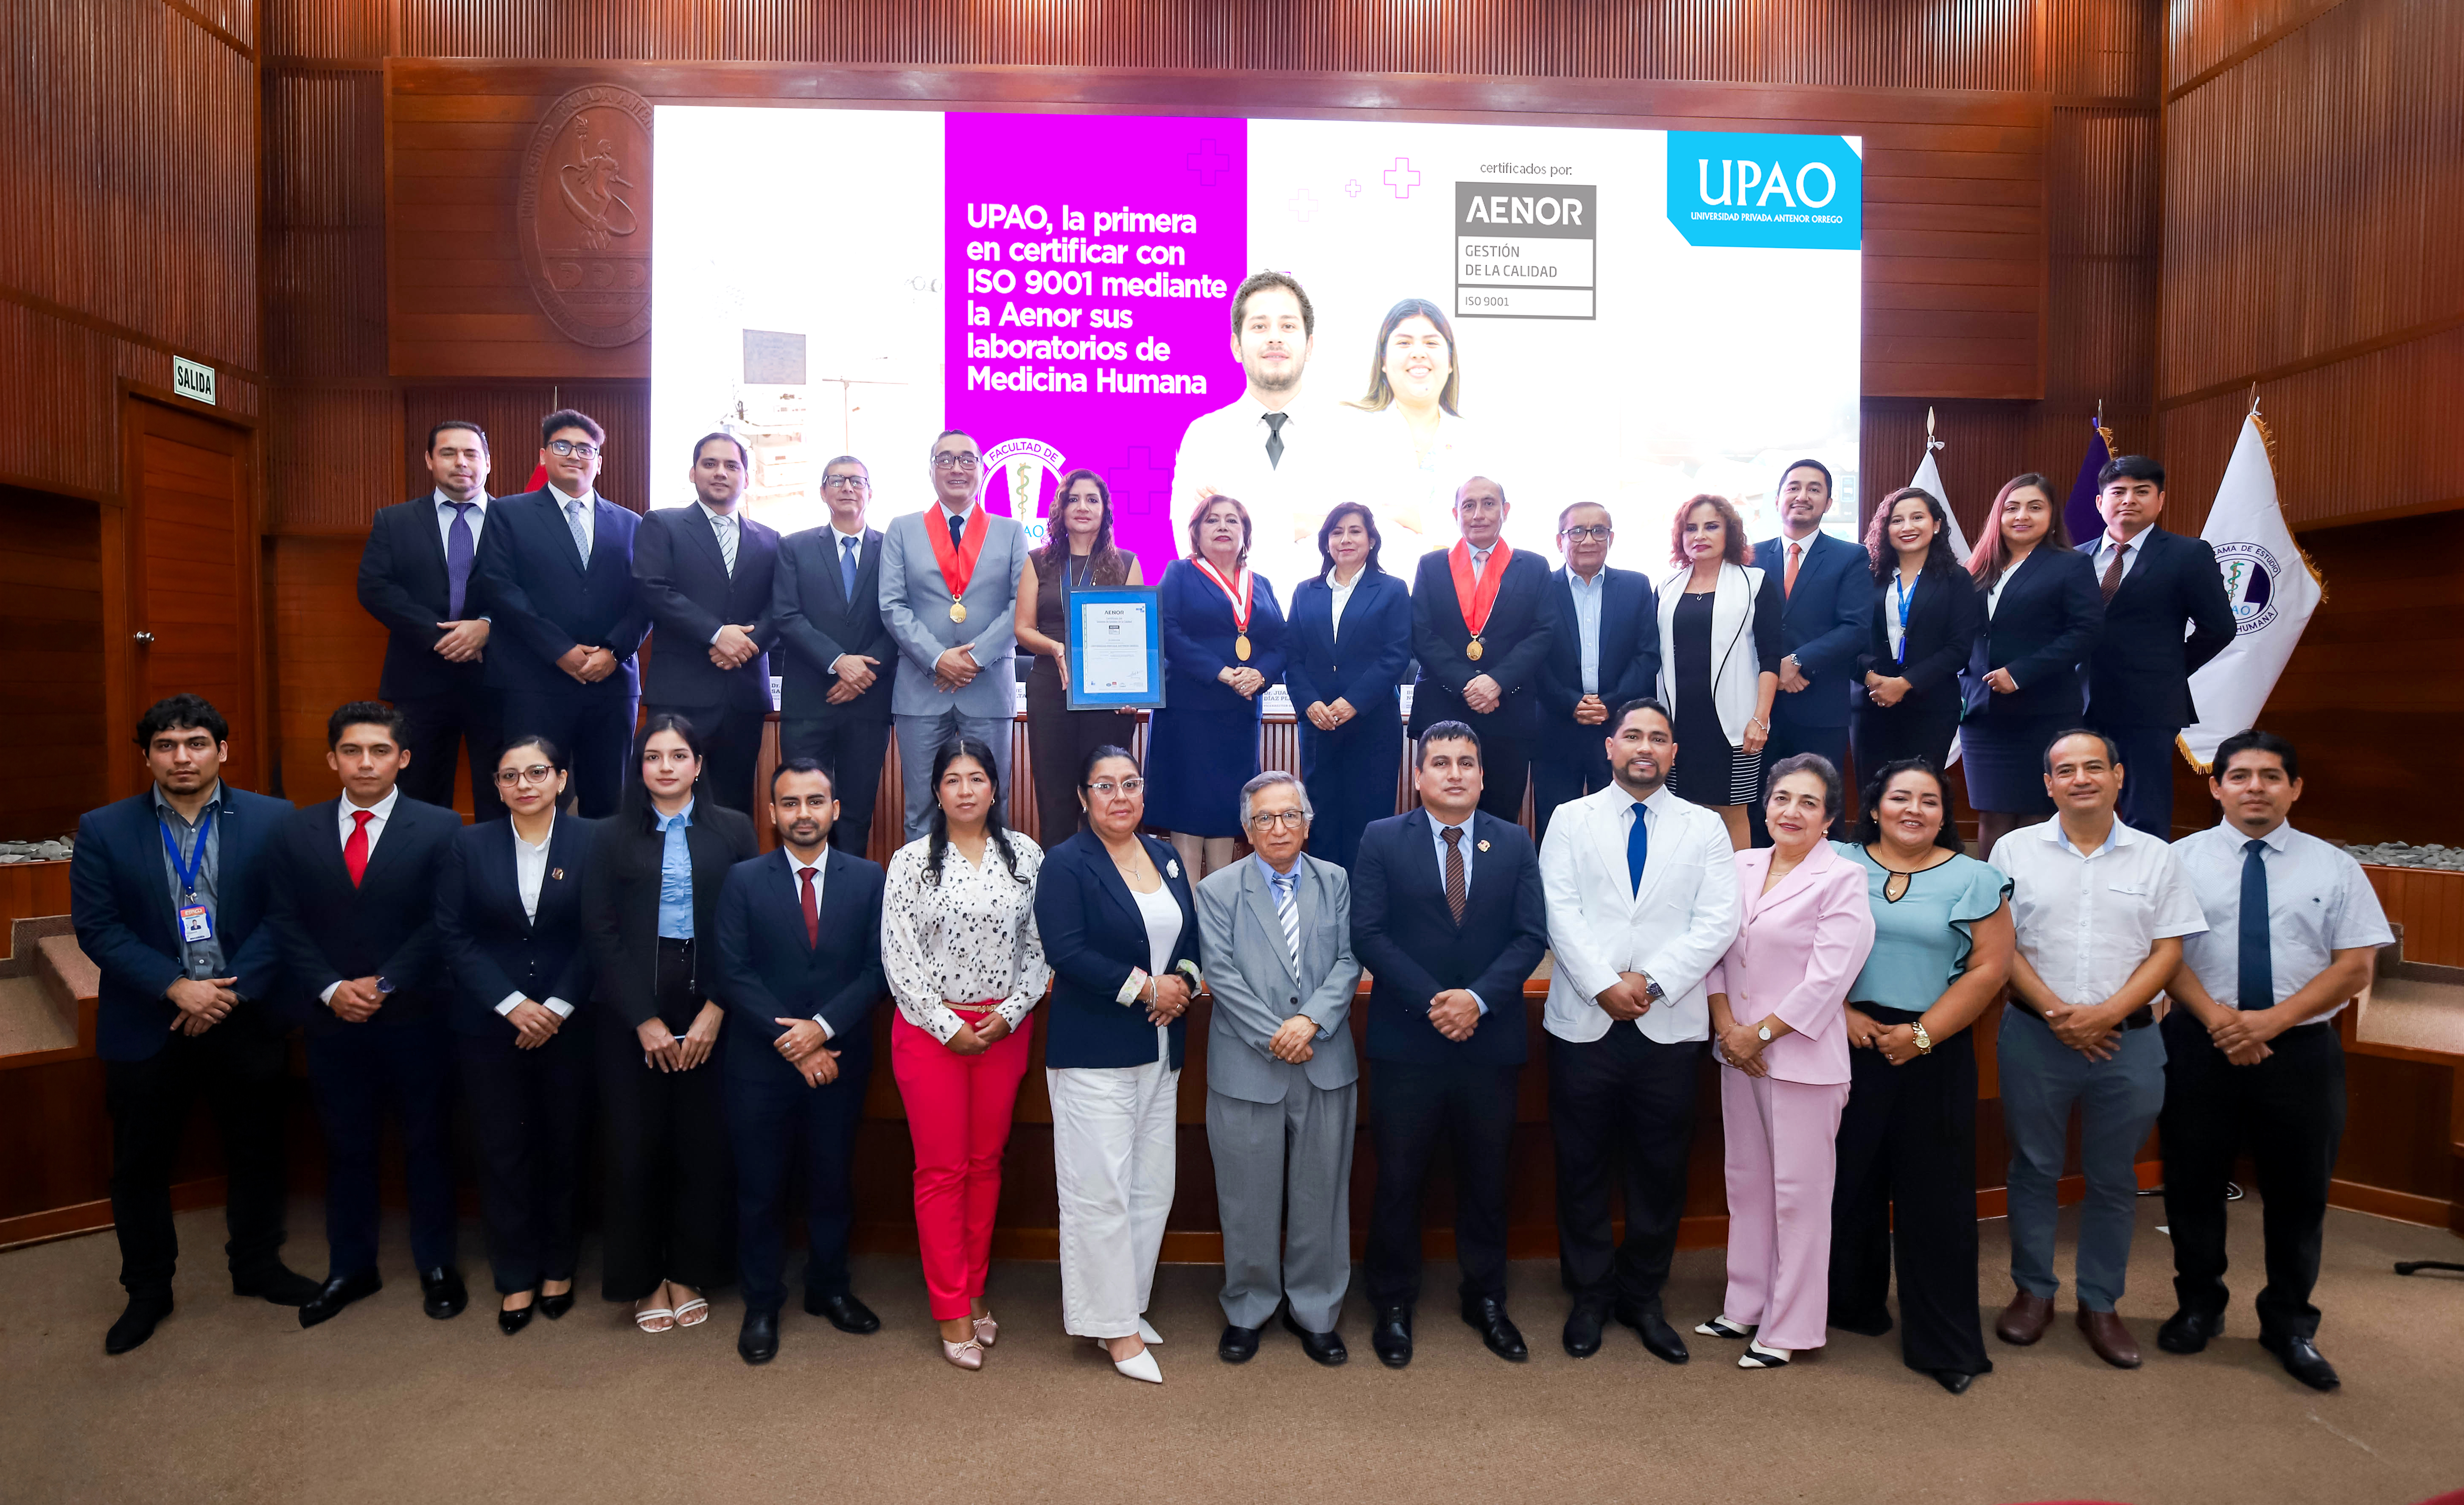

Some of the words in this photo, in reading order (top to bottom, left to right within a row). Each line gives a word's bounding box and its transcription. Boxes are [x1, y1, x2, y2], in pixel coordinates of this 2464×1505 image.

[1481, 162, 1546, 174] certificados
[1551, 167, 1572, 177] por:
[1699, 159, 1836, 208] UPAO
[968, 203, 1053, 235] UPAO,
[1063, 205, 1085, 231] la
[1094, 206, 1196, 236] primera
[1466, 196, 1582, 225] AENOR
[1691, 212, 1739, 221] UNIVERSIDAD
[1742, 213, 1772, 221] PRIVADA
[1774, 214, 1810, 222] ANTENOR
[1812, 215, 1842, 223] ORREGO
[967, 241, 1000, 261] en
[1009, 237, 1128, 264] certificar
[1136, 245, 1184, 265] con
[1466, 243, 1519, 257] GESTIÓN
[968, 269, 1016, 294] ISO
[1025, 270, 1092, 295] 9001
[1103, 272, 1227, 298] mediante
[1466, 264, 1481, 276] DE
[1485, 265, 1500, 276] LA
[1504, 265, 1557, 277] CALIDAD
[968, 300, 990, 326] la
[999, 302, 1082, 327] Aenor
[1089, 309, 1133, 328] sus
[1466, 297, 1481, 305] ISO
[1484, 297, 1509, 306] 9001
[968, 333, 1127, 361] laboratorios
[1136, 336, 1170, 361] de
[177, 365, 211, 395] SALIDA
[968, 366, 1087, 392] Medicina
[1097, 368, 1206, 394] Humana
[989, 442, 1041, 462] FACULTAD
[1044, 448, 1059, 462] DE
[1025, 525, 1044, 537] AO
[2255, 548, 2279, 573] ESTUDIO
[2232, 605, 2250, 615] AO
